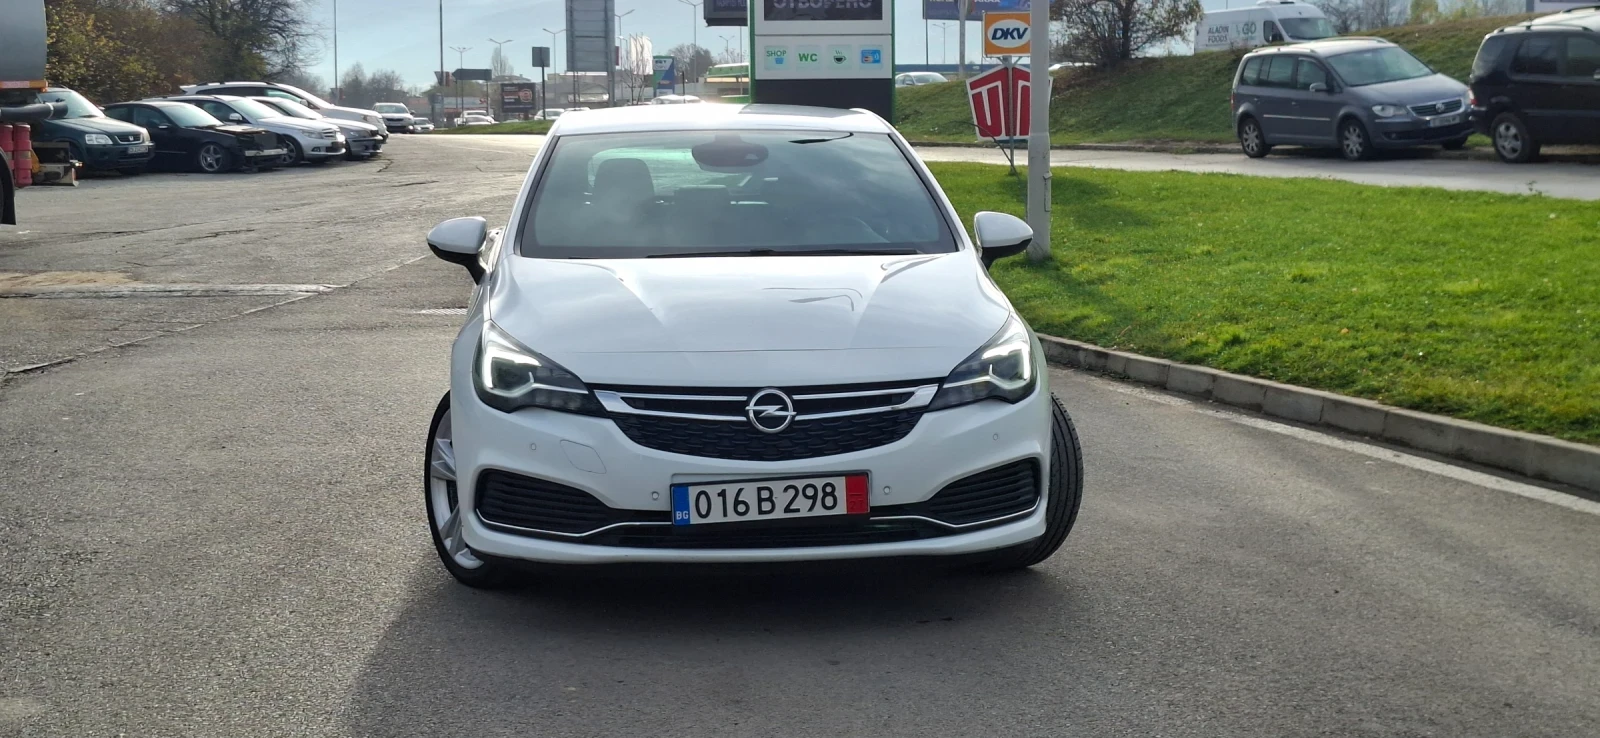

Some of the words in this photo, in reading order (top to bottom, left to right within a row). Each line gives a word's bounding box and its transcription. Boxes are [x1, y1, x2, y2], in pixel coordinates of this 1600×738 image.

[991, 27, 1028, 40] DKV
[1208, 34, 1228, 43] FOODS
[798, 53, 818, 62] WC
[676, 511, 689, 520] BG
[695, 488, 750, 519] 016
[757, 486, 776, 515] B
[783, 482, 838, 514] 298
